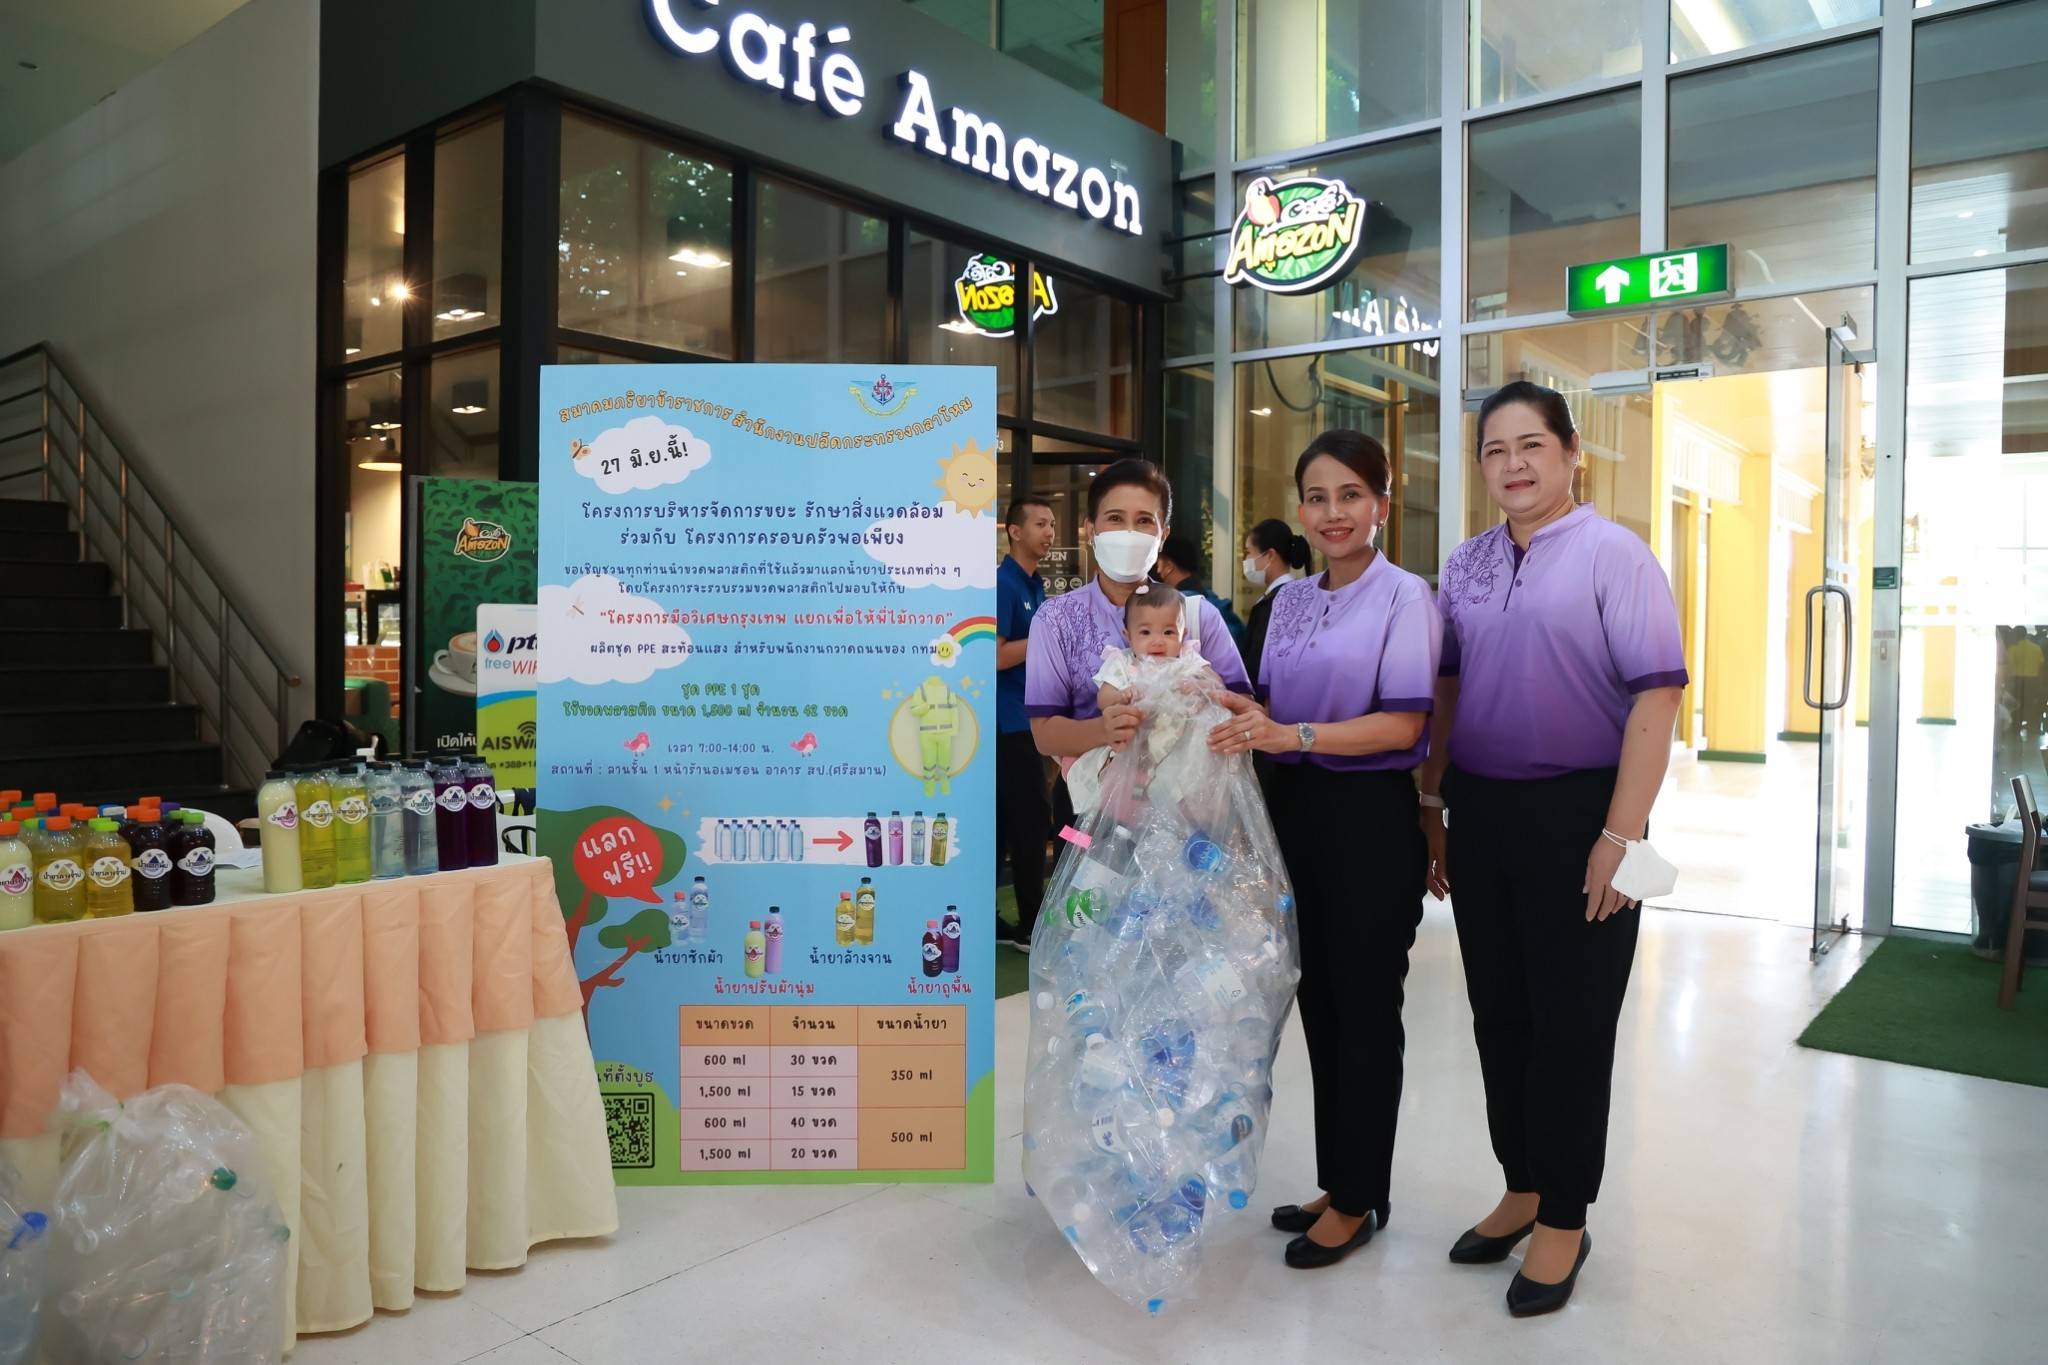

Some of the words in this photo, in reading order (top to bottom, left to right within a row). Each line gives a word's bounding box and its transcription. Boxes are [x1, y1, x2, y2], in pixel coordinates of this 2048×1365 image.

[650, 0, 866, 118] Café
[893, 69, 1144, 236] Amazon
[600, 457, 620, 476] 27
[581, 500, 797, 519] โครงการบริหารจัดการขยะ
[805, 496, 943, 520] รักษาสิ่งแวดล้อม
[620, 527, 676, 545] ร่วมกับ
[684, 527, 904, 545] โครงการครอบครัวพอเพียง
[506, 632, 537, 654] pt
[590, 640, 632, 658] ผลิตชุด
[637, 643, 656, 655] PPE
[661, 640, 728, 655] สะท้อนแสง
[680, 683, 701, 700] ชุด
[704, 683, 727, 697] PPE
[730, 683, 738, 696] 1
[741, 683, 761, 700] ชุด
[667, 743, 694, 753] เวลา
[698, 743, 756, 754] 7:00-14:00
[761, 744, 775, 754] น.
[551, 759, 593, 775] สถานที่
[607, 758, 649, 775] ลานชั้น
[765, 765, 802, 776] อาคาร
[582, 826, 636, 858] แลก
[603, 850, 653, 886] ฟรี!!
[653, 946, 723, 966] น้ำยาซักผ้า
[809, 946, 893, 965] น้ำยาล้างจาน
[713, 975, 815, 999] น้ำยาปรับผ้านุ่ม
[907, 974, 972, 999] น้ำยาถูพื้น
[695, 1019, 754, 1030] ขนาดขวด
[791, 1015, 836, 1030] จำนวน
[876, 1012, 947, 1030] ขนาดน้ำยา
[703, 1054, 727, 1066] 600
[732, 1053, 747, 1066] ml
[790, 1054, 806, 1066] 30
[811, 1055, 838, 1066] ขวด
[890, 1069, 913, 1081] 350
[919, 1068, 933, 1081] ml
[699, 1085, 732, 1099] 1,500
[737, 1085, 751, 1097] ml
[791, 1085, 805, 1097] 15
[810, 1086, 837, 1097] ขวด
[704, 1116, 727, 1129] 600
[732, 1116, 746, 1129] ml
[790, 1116, 806, 1128] 40
[811, 1117, 837, 1128] ขวด
[890, 1131, 914, 1143] 500
[919, 1131, 933, 1143] ml
[699, 1147, 732, 1161] 1,500
[737, 1147, 751, 1160] ml
[790, 1147, 806, 1159] 20
[811, 1148, 838, 1159] ขวด
